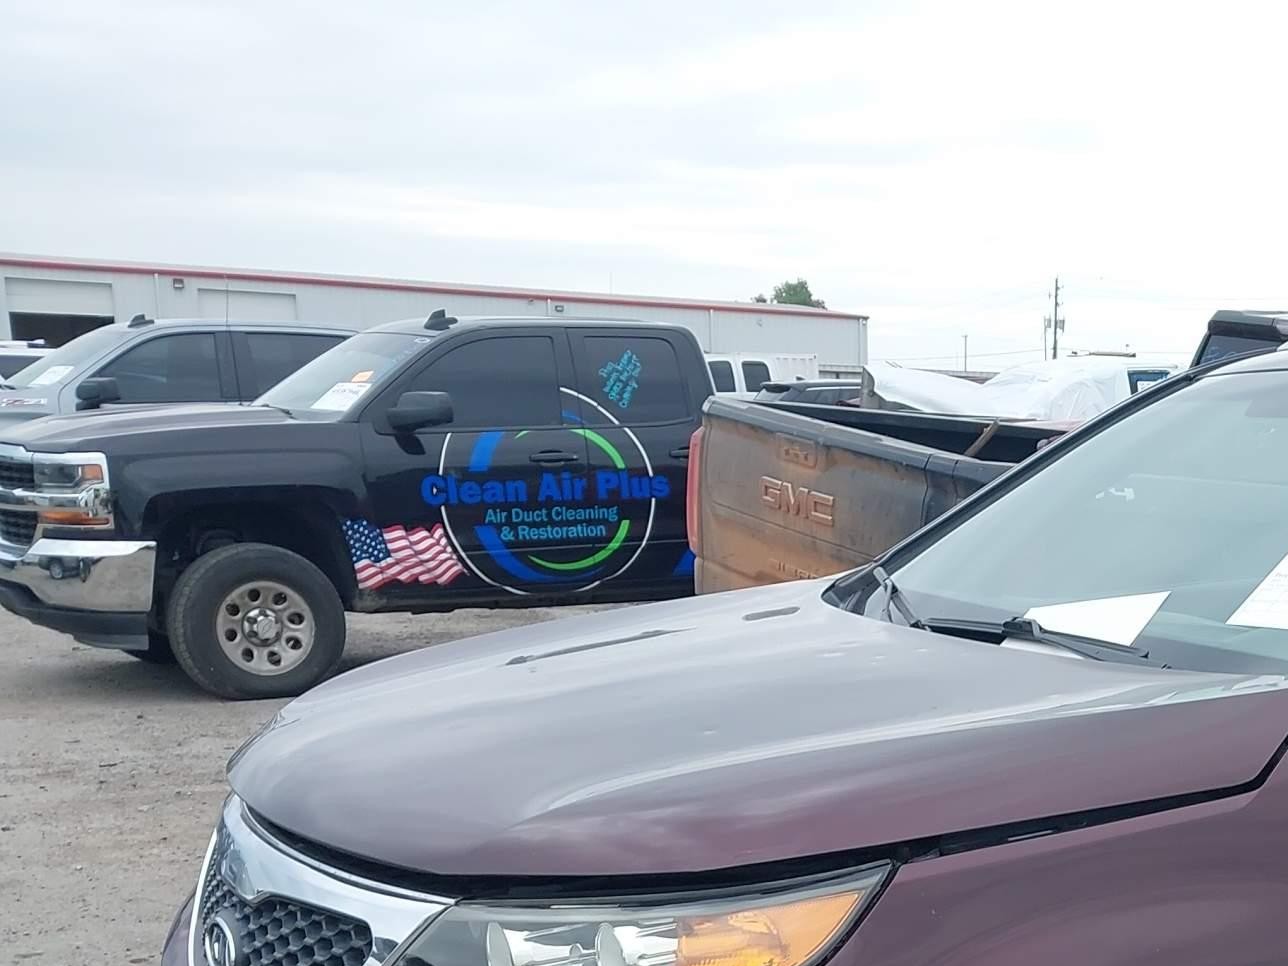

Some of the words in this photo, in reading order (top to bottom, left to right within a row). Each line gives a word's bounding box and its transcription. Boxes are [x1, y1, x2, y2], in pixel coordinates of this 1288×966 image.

[420, 474, 527, 505] Clean
[538, 472, 586, 501] Air
[596, 470, 670, 500] Plus
[760, 475, 834, 526] GMC
[485, 508, 507, 524] Air
[512, 507, 548, 522] Duct
[551, 505, 619, 521] Cleaning
[500, 526, 515, 541] &
[518, 523, 607, 540] Restoration
